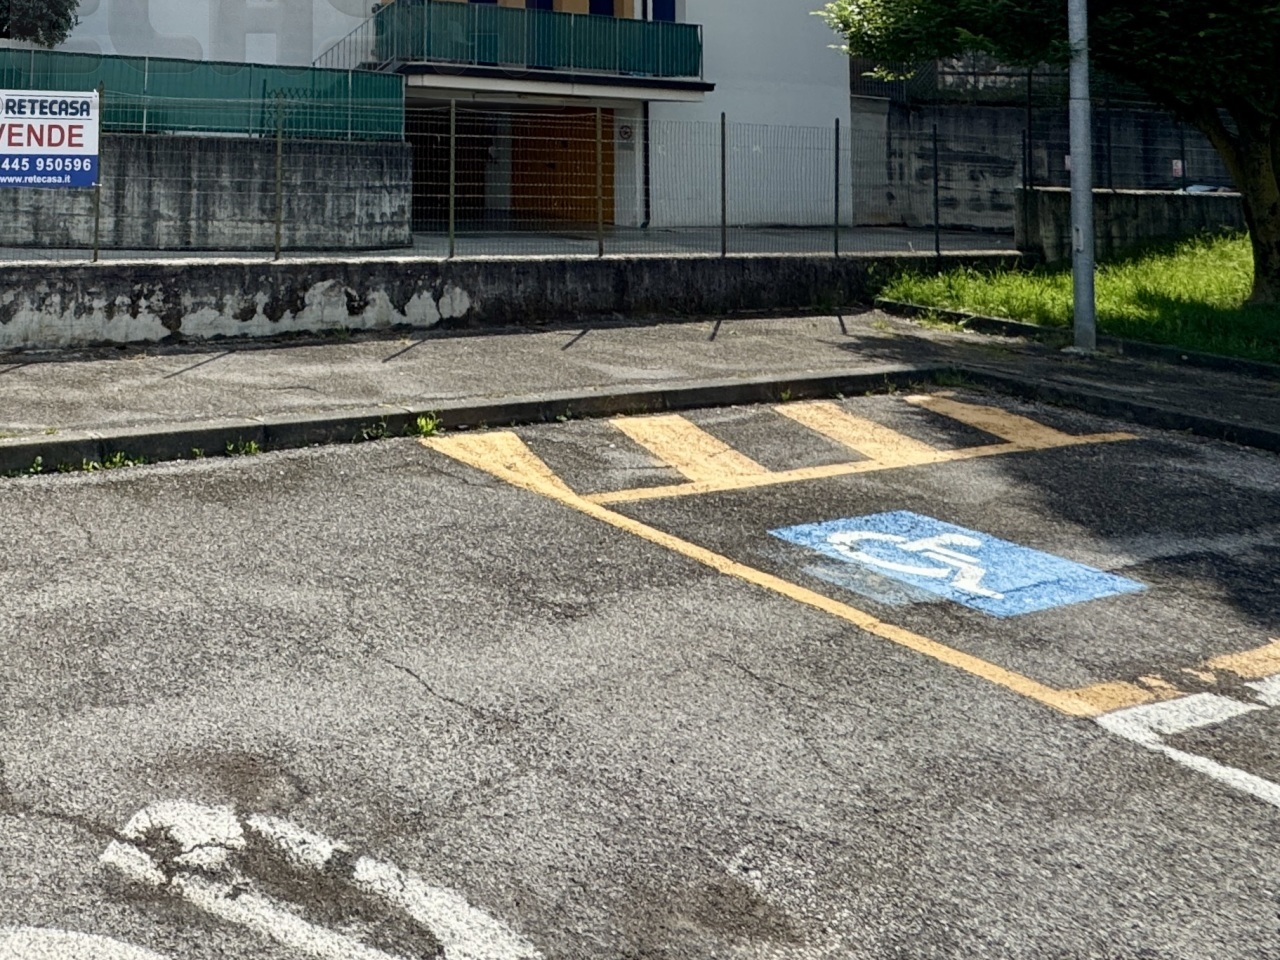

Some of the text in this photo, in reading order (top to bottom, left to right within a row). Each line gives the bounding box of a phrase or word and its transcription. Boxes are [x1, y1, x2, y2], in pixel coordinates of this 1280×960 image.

[5, 98, 91, 117] RETECASA
[35, 157, 92, 172] 950596
[0, 174, 71, 184] www.retecasa.it
